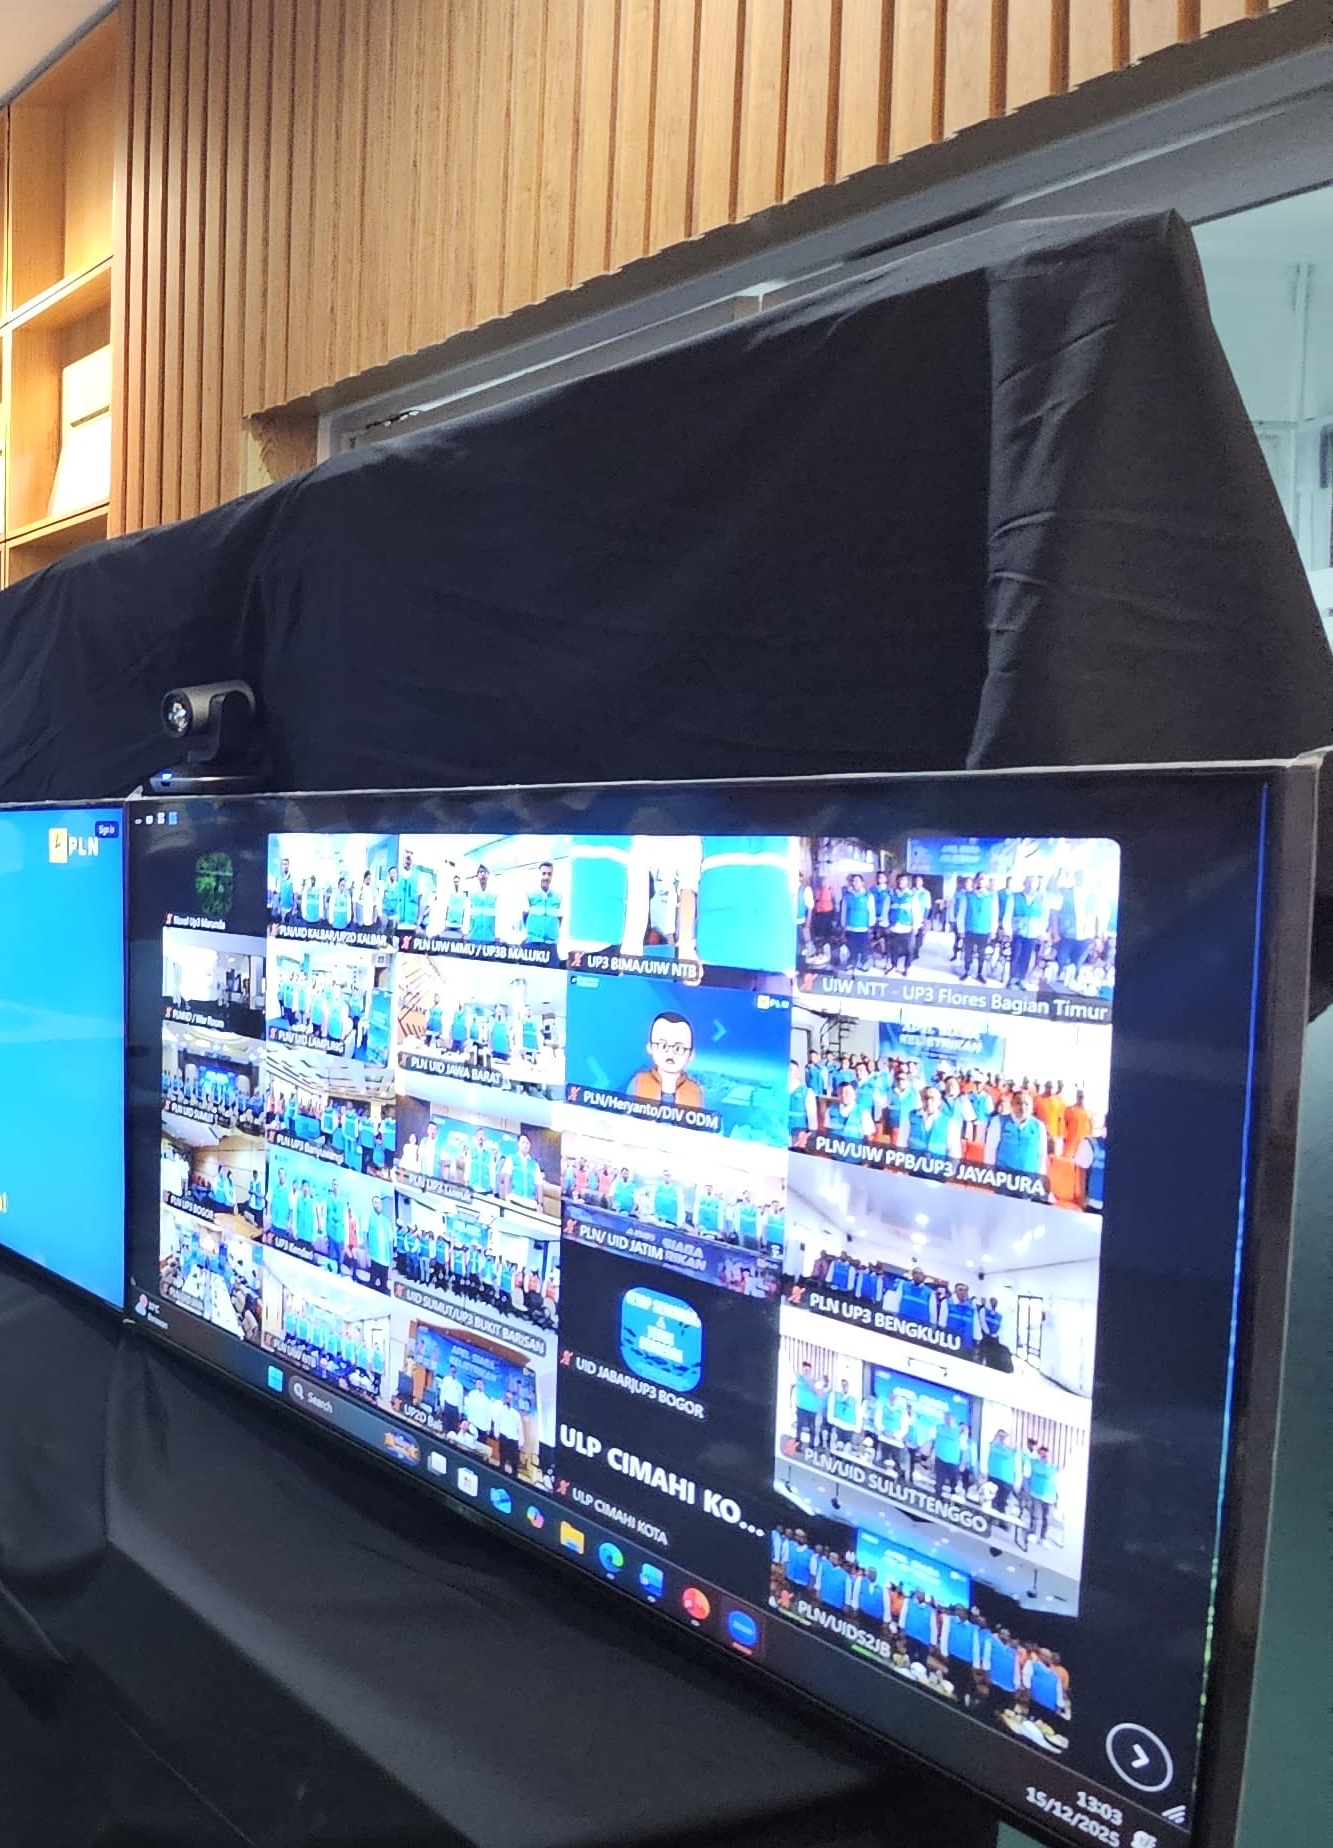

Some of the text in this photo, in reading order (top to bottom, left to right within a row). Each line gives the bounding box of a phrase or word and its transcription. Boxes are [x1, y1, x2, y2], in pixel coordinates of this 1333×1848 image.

[68, 836, 99, 857] PLN
[414, 938, 431, 951] PLN
[432, 940, 449, 953] UIW
[451, 942, 475, 956] MMU
[482, 945, 507, 959] UP3B
[508, 947, 550, 963] MALUKU
[587, 956, 697, 978] UP3 BIMA/UIW NTB
[822, 977, 855, 995] UIW
[857, 979, 889, 997] NTT
[902, 984, 935, 1002] UP3
[937, 988, 987, 1008] Flores
[991, 994, 1049, 1018] Bagian
[1053, 998, 1109, 1021] Timur
[308, 1036, 344, 1055] LAMPUNG
[410, 1055, 501, 1085] PLN UID JAWA BARAT
[583, 1091, 719, 1129] PLN/Heryanto/DIV ODM
[815, 1136, 1046, 1196] PLN/UIW PPB/UP3 JAYAPURA
[580, 1224, 603, 1244] PLN/
[607, 1232, 627, 1251] UID
[628, 1239, 664, 1261] JATIM
[406, 1288, 545, 1354] UID SUMUT/UP3 BUKIT BARISAN
[810, 1293, 962, 1351] PLN UP3 BENGKULU
[575, 1357, 596, 1375] UID
[658, 1390, 705, 1419] BOGOR
[404, 1403, 427, 1425] UP2D
[560, 1424, 602, 1459] ULP
[607, 1447, 696, 1505] CIMAHI
[804, 1449, 989, 1534] PLN/UID SULUTTENGGO
[572, 1487, 669, 1547] ULP CIMAHI KOTA
[797, 1600, 891, 1657] PLN/UIDS2JB
[1025, 1786, 1121, 1848] 15/12/2025
[1077, 1791, 1123, 1826] 13:03
